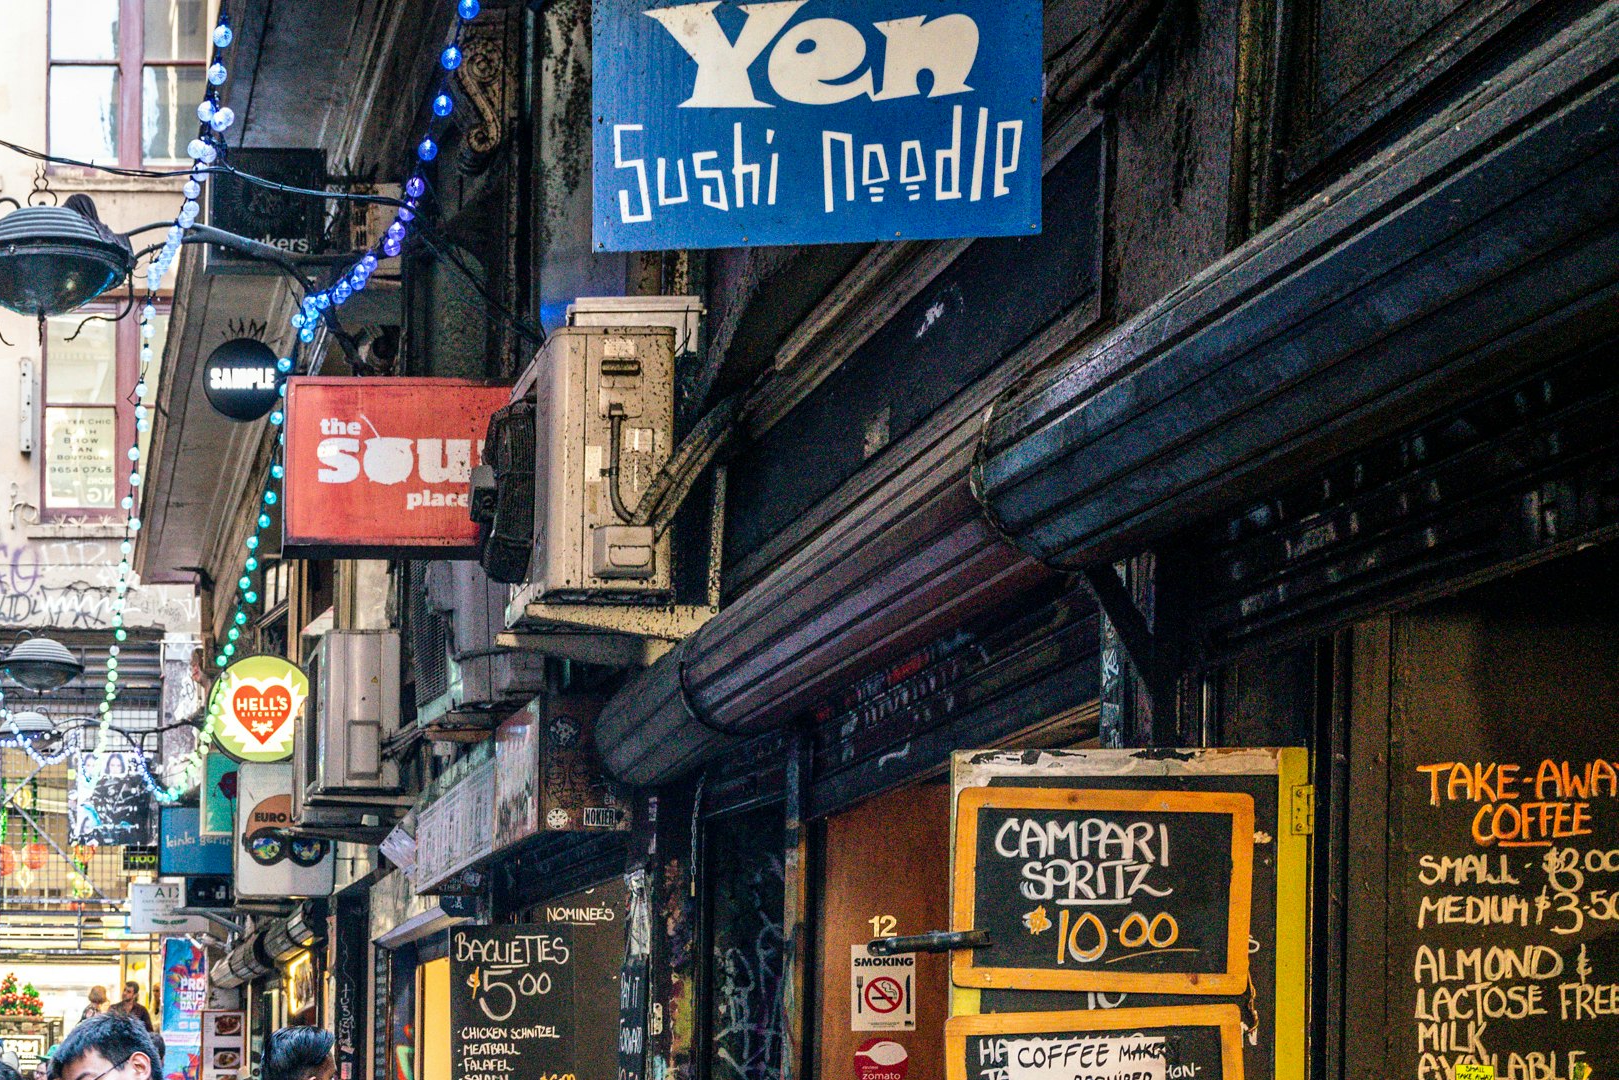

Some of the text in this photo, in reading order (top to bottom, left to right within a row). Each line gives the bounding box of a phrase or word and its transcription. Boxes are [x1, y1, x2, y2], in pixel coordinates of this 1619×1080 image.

[642, 0, 980, 108] Yen
[613, 121, 779, 223] Sushi
[209, 367, 275, 390] SAMPLE
[320, 417, 362, 436] the
[236, 695, 289, 711] HELL'S
[1416, 758, 1619, 808] TAKE-AWA
[254, 812, 287, 823] EURO
[1471, 802, 1593, 846] COFFEE
[995, 817, 1169, 868] CAMPARI
[1020, 858, 1174, 900] SPRITZ
[1418, 853, 1521, 886] SMALL
[868, 914, 897, 938] 12
[1417, 893, 1529, 930] MEDIUM
[854, 957, 913, 967] SMOKING
[1414, 944, 1565, 985] ALMOND
[1414, 982, 1549, 1027] LACTOSE
[461, 1024, 561, 1040] CHICKEN SCHNITZEL
[1418, 1020, 1487, 1060] MILK
[463, 1042, 522, 1056] MEATBALL
[1017, 1042, 1110, 1069] COFFEE
[463, 1057, 515, 1073] FALAFEL
[862, 1071, 901, 1080] zomato
